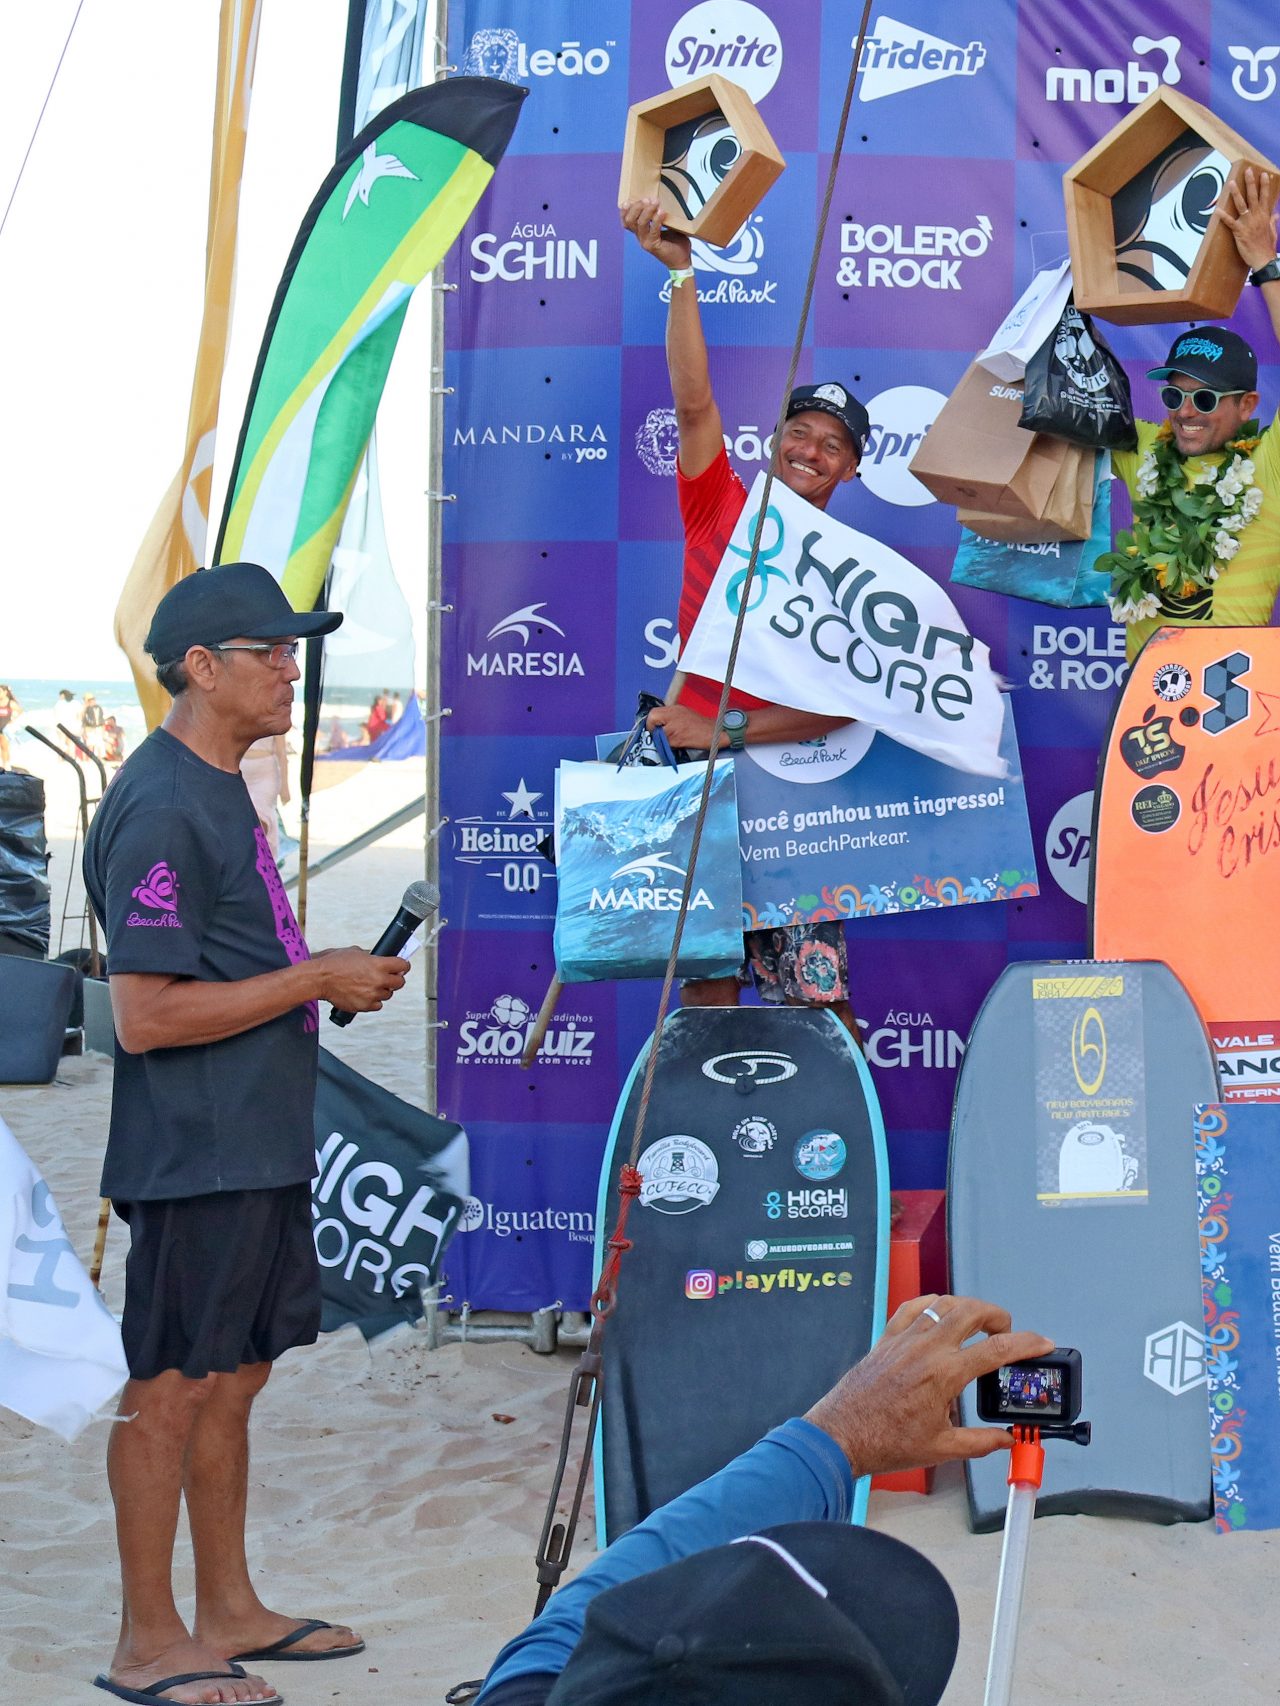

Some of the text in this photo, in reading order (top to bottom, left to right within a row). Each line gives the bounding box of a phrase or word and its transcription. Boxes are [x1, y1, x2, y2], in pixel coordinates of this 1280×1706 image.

[671, 36, 776, 76] Sprite
[853, 35, 987, 75] Trident
[511, 222, 556, 238] ÁGUA
[841, 222, 990, 258] BOLERO
[470, 233, 598, 283] SCHIN
[836, 259, 963, 290] & ROCK
[452, 424, 608, 445] MANDARA
[722, 425, 775, 460] eão
[561, 447, 608, 463] BY yoo
[1034, 625, 1128, 656] BOLE
[467, 653, 585, 677] MARESIA
[1028, 660, 1055, 691] &
[741, 787, 1005, 834] você ganhou um ingresso!
[461, 827, 551, 853] Heine
[740, 829, 910, 864] Vem BeachParkear.
[504, 862, 540, 892] 0.0
[126, 912, 183, 928] BeachPa
[466, 1010, 491, 1020] Super
[884, 1009, 934, 1026] ÁGUA
[1213, 1034, 1275, 1048] VALE
[456, 1056, 592, 1066] Me acostum com você
[788, 1188, 844, 1206] HIGH
[486, 1206, 593, 1236] Iguatem
[718, 1268, 853, 1294] playfly.ce
